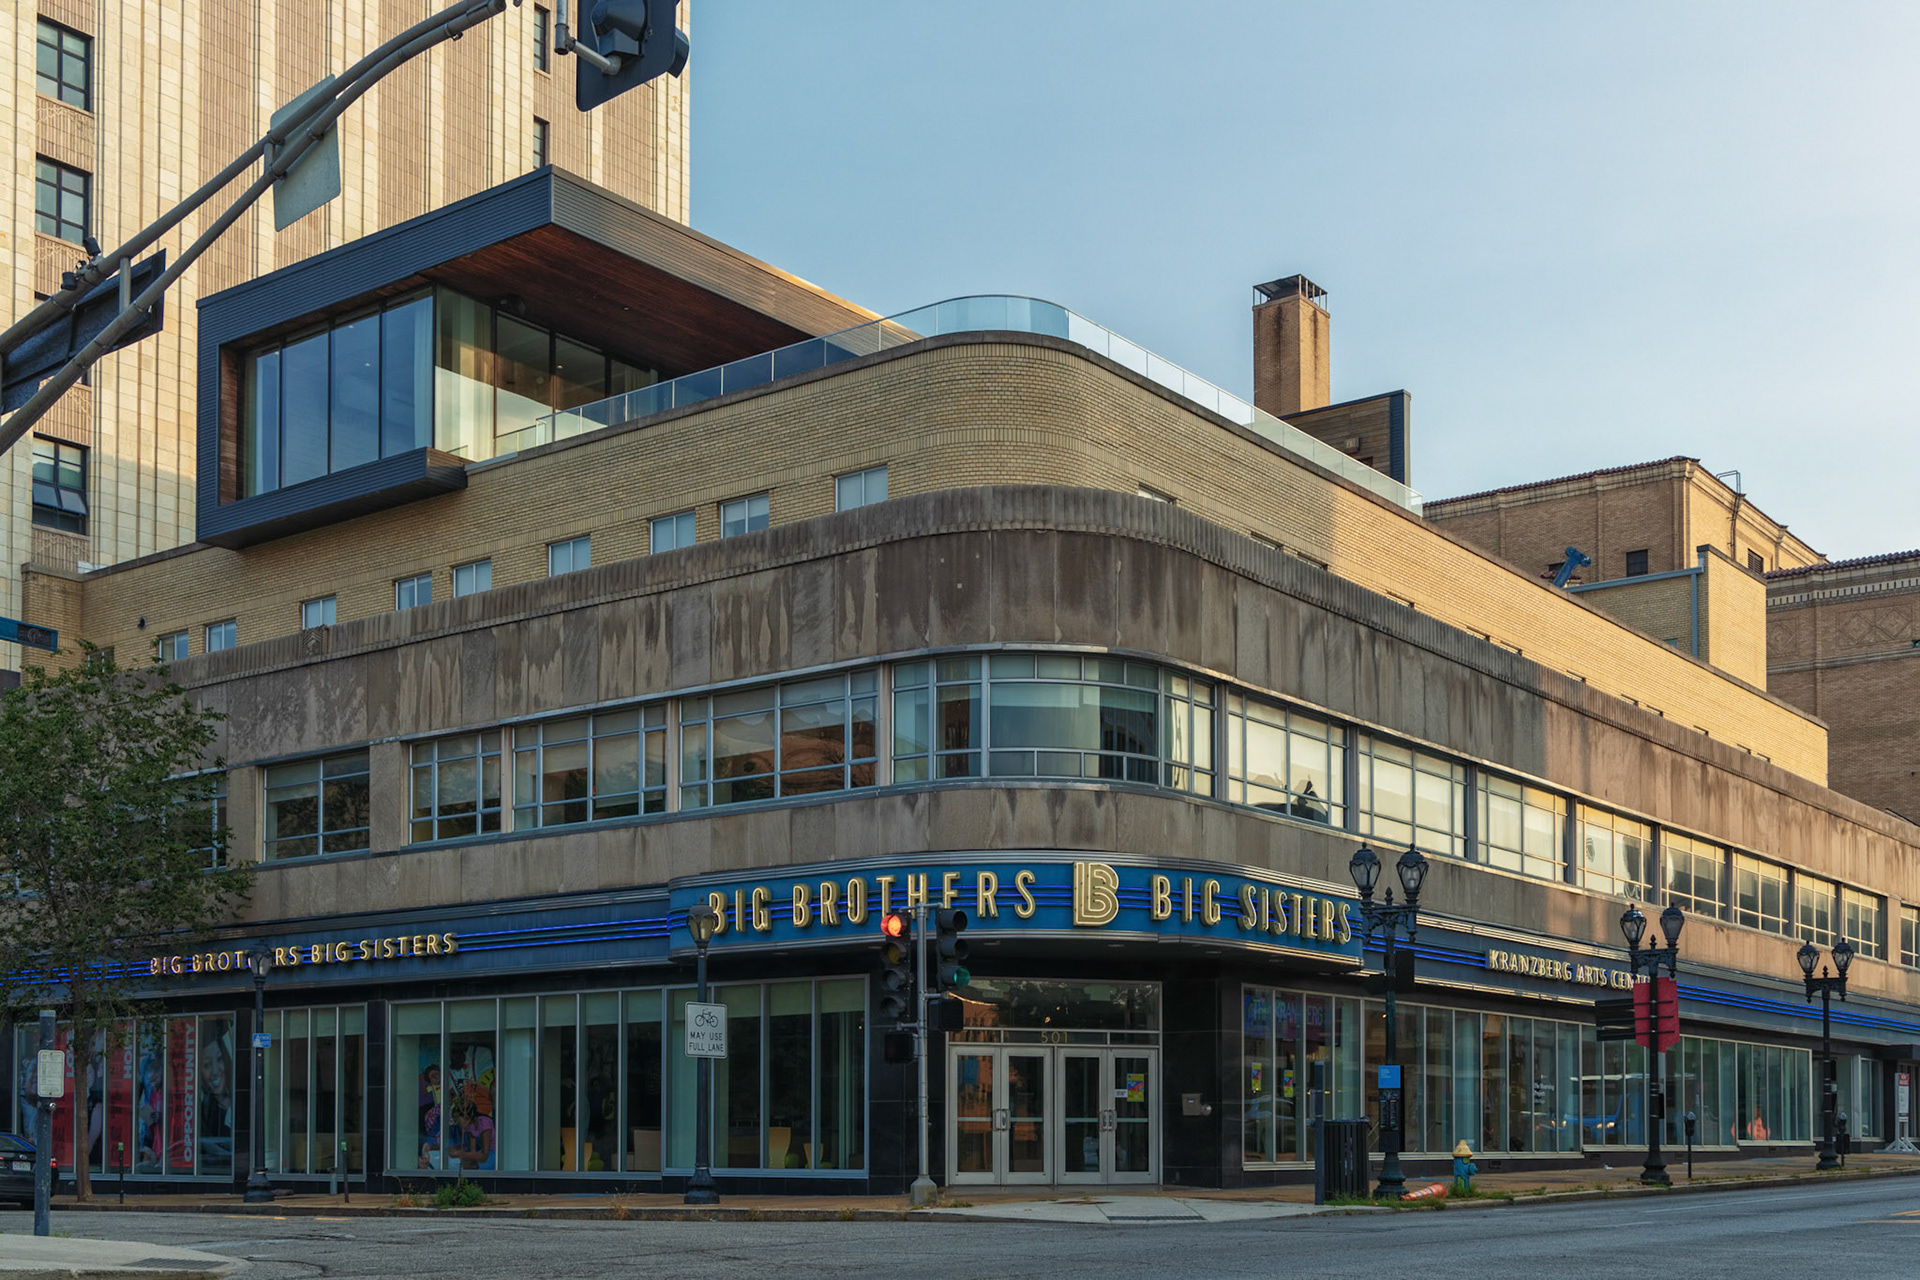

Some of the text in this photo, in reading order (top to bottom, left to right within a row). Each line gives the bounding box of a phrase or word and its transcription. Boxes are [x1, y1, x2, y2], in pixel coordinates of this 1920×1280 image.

[709, 886, 772, 934] BIG
[793, 870, 1036, 927] BROTHERS
[1152, 874, 1221, 926] BIG
[1237, 884, 1351, 945] SISTERS
[150, 932, 458, 975] BIG BROTRS BIG SISTERS
[1489, 949, 1572, 981] KRANZBERG
[1576, 963, 1608, 987] ARTS
[689, 1041, 724, 1052] FULL LANE
[690, 1031, 723, 1041] MAY USE
[1040, 1031, 1068, 1044] 501
[184, 1023, 195, 1162] OPPORTUNITY
